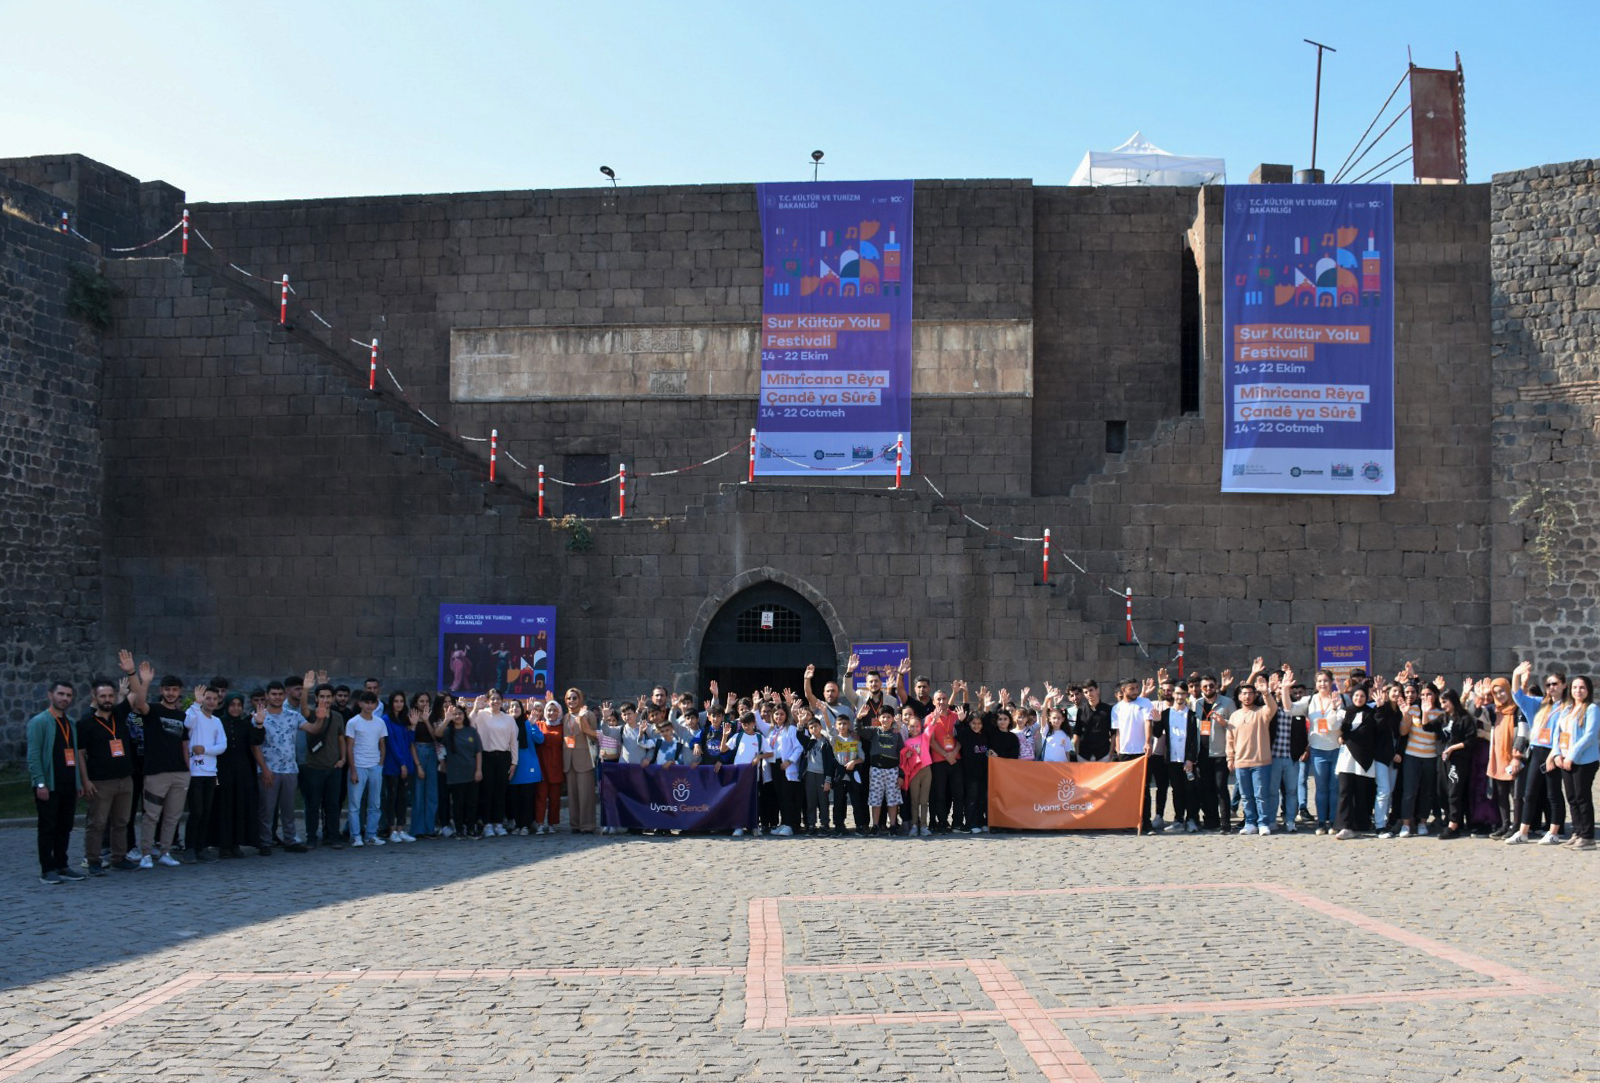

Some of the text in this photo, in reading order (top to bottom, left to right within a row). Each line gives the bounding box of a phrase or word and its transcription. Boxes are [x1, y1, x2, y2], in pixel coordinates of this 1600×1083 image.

[768, 317, 880, 328] Sur Kültür Yolu
[1240, 328, 1359, 340] Sur Kültür Yolu
[768, 335, 831, 346] Festivali
[762, 352, 775, 360] 14
[785, 352, 798, 360] 22
[801, 352, 828, 360] Ekim
[1240, 347, 1308, 359] Festivali
[1234, 364, 1249, 374] 14
[1259, 364, 1273, 373] 22
[1276, 363, 1305, 373] Ekim
[767, 374, 885, 387] Mîhrîcana Rêya
[767, 392, 876, 406] Çandê ya Sûrê
[1240, 387, 1364, 402] Mîhrîcana Rêya
[761, 409, 774, 417] 14
[784, 409, 797, 417] 22
[800, 409, 845, 417] Cotmeh
[1240, 406, 1356, 421] Çandê ya Sûrê
[1234, 424, 1248, 434] 14
[1259, 423, 1273, 432] 22
[1276, 423, 1324, 433] Cotmeh
